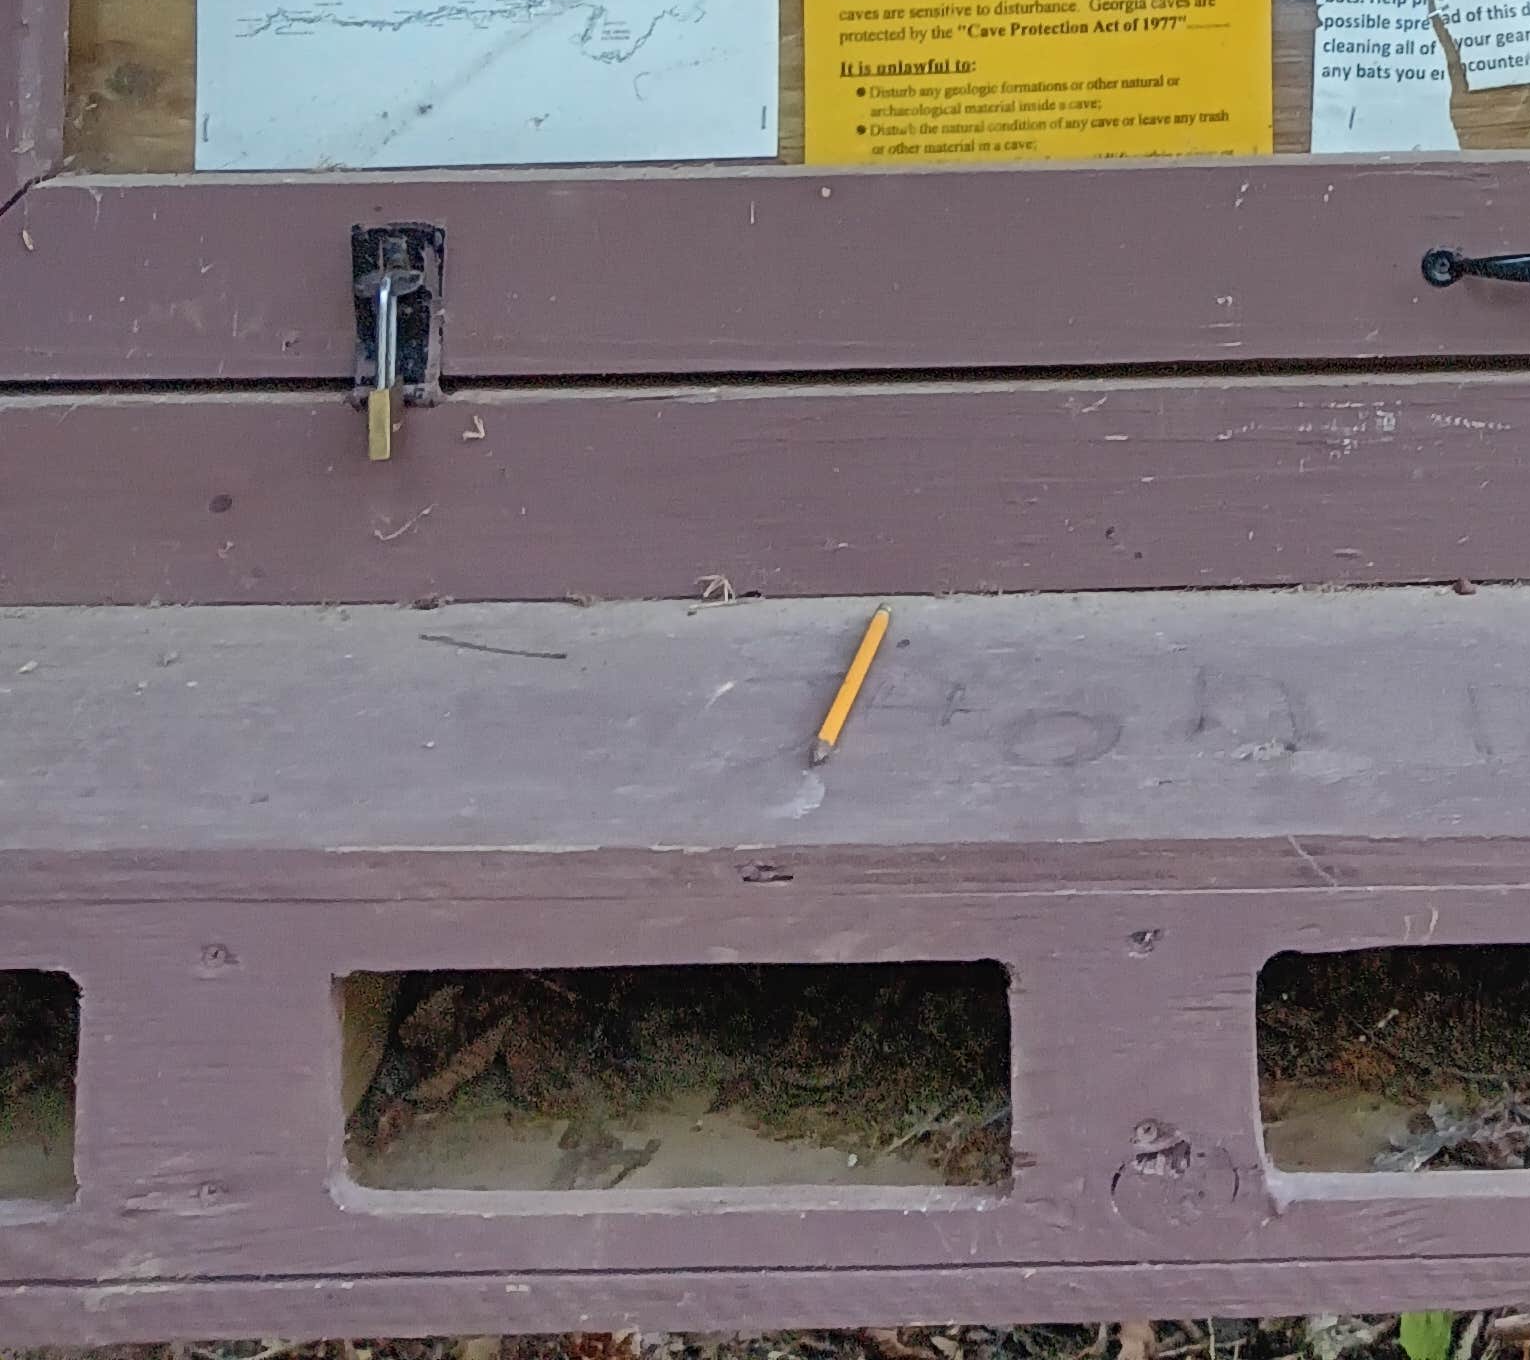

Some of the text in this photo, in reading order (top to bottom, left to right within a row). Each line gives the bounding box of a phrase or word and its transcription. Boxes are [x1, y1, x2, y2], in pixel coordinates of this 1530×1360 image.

[1010, 20, 1089, 37] Protection
[1092, 20, 1120, 33] Act
[1123, 17, 1140, 32] of
[1322, 37, 1437, 58] cleaning all of
